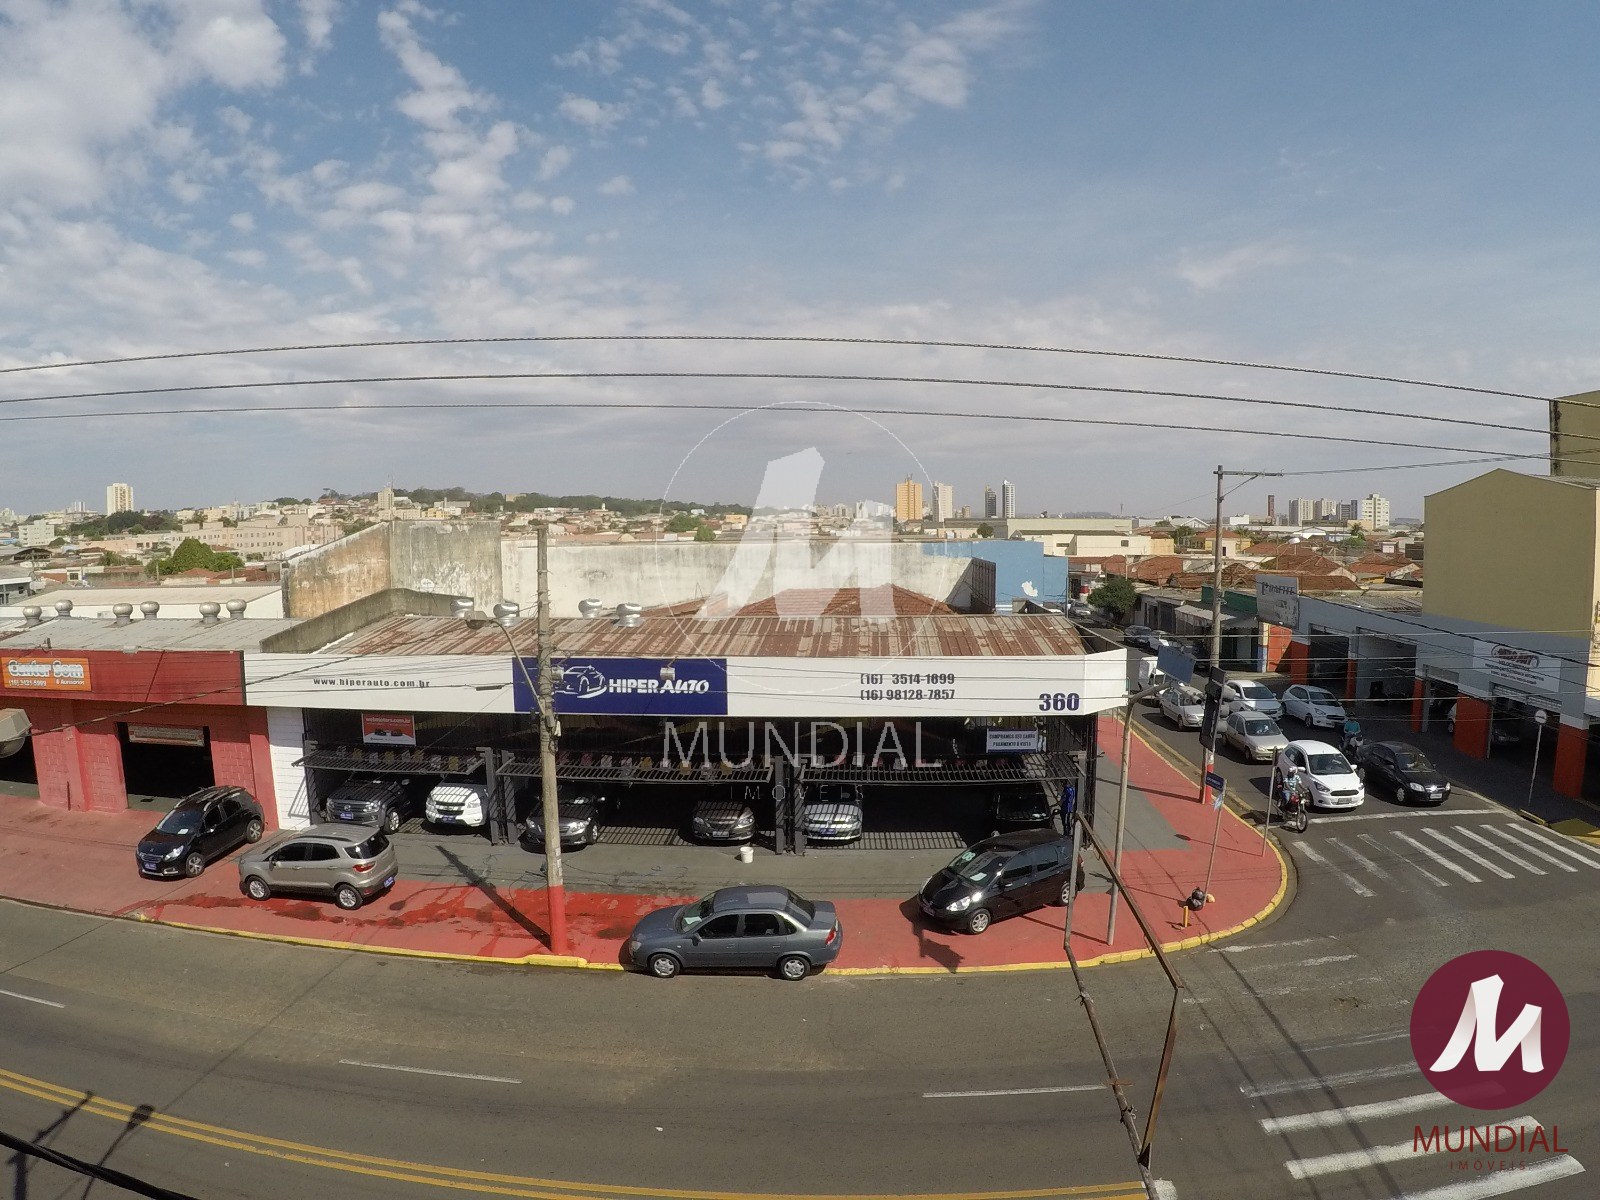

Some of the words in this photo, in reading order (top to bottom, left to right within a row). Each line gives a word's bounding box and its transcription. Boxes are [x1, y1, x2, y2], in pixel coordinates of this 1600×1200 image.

[8, 660, 52, 677] Center
[53, 660, 84, 678] Som
[313, 678, 430, 688] www.hiperauto.com.br
[860, 673, 883, 685] (16)
[860, 689, 883, 700] (16)
[886, 689, 955, 700] 98128-7857
[1038, 693, 1080, 711] 360
